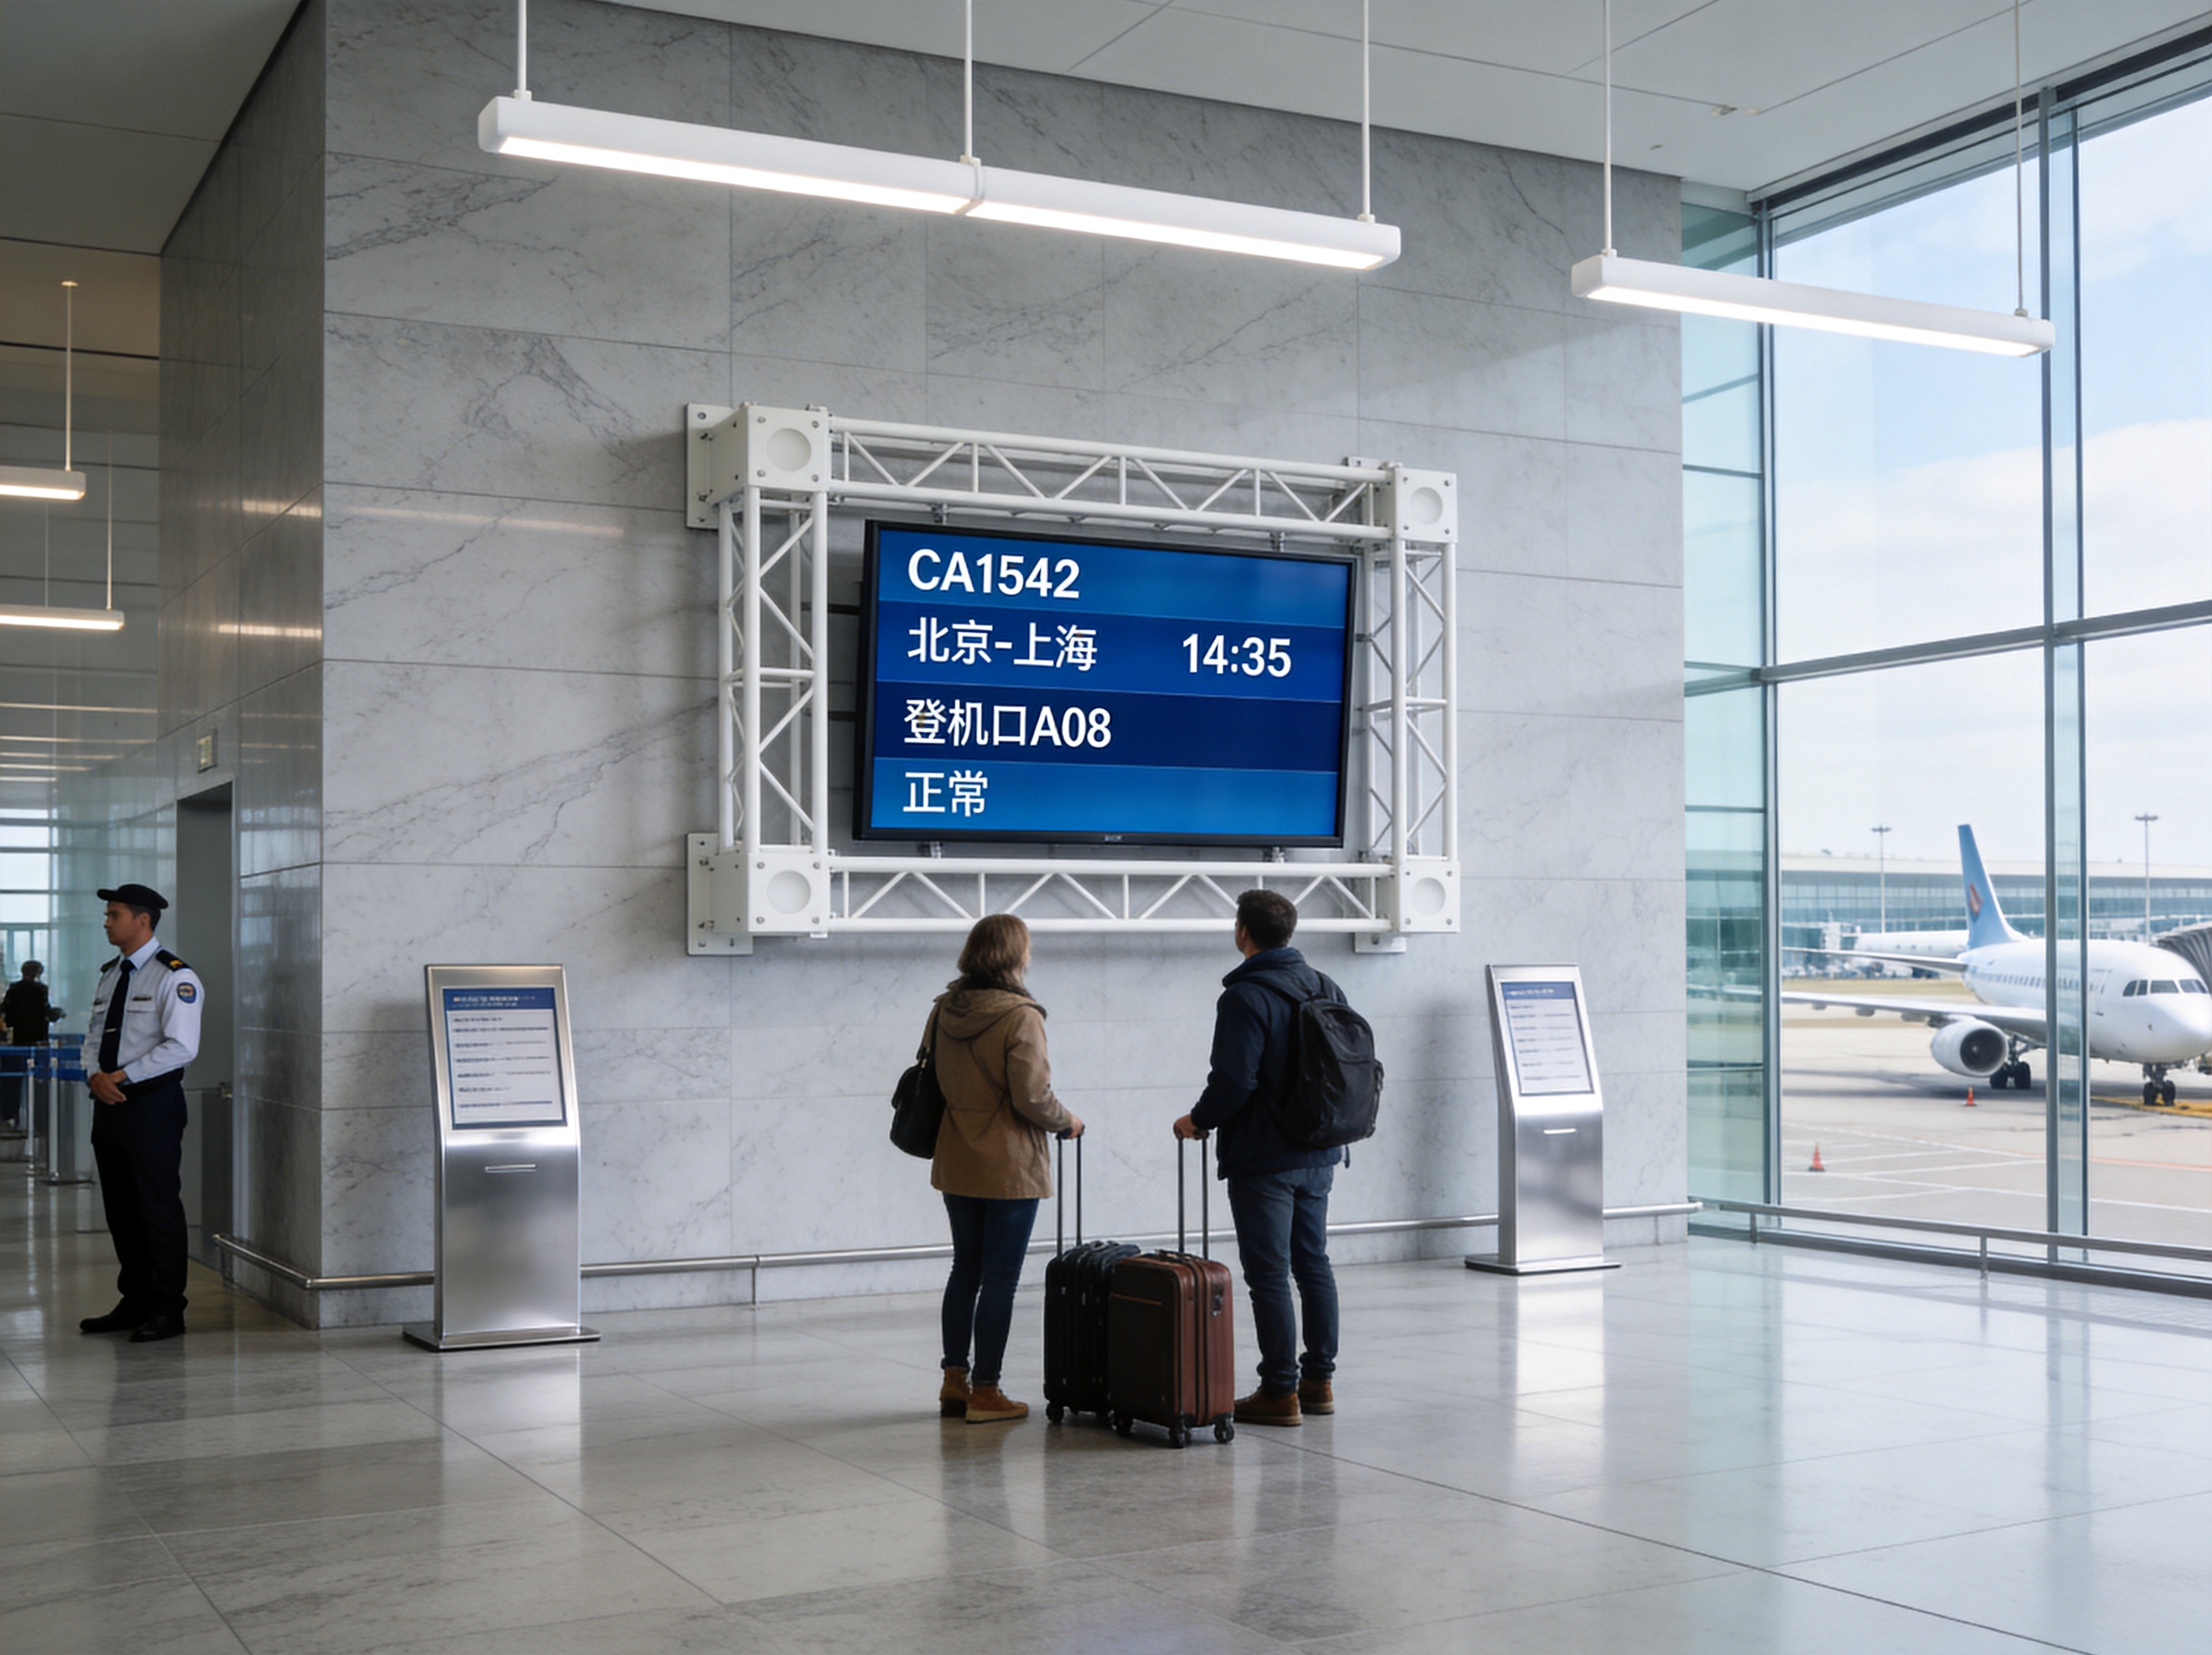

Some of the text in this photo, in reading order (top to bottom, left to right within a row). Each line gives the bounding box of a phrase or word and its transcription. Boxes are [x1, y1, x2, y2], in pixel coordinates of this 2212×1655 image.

[908, 548, 1080, 599] CA1542
[907, 616, 1292, 678] 北京-上海 14:35
[904, 698, 1112, 748] 登机口A08
[902, 769, 988, 817] 正常
